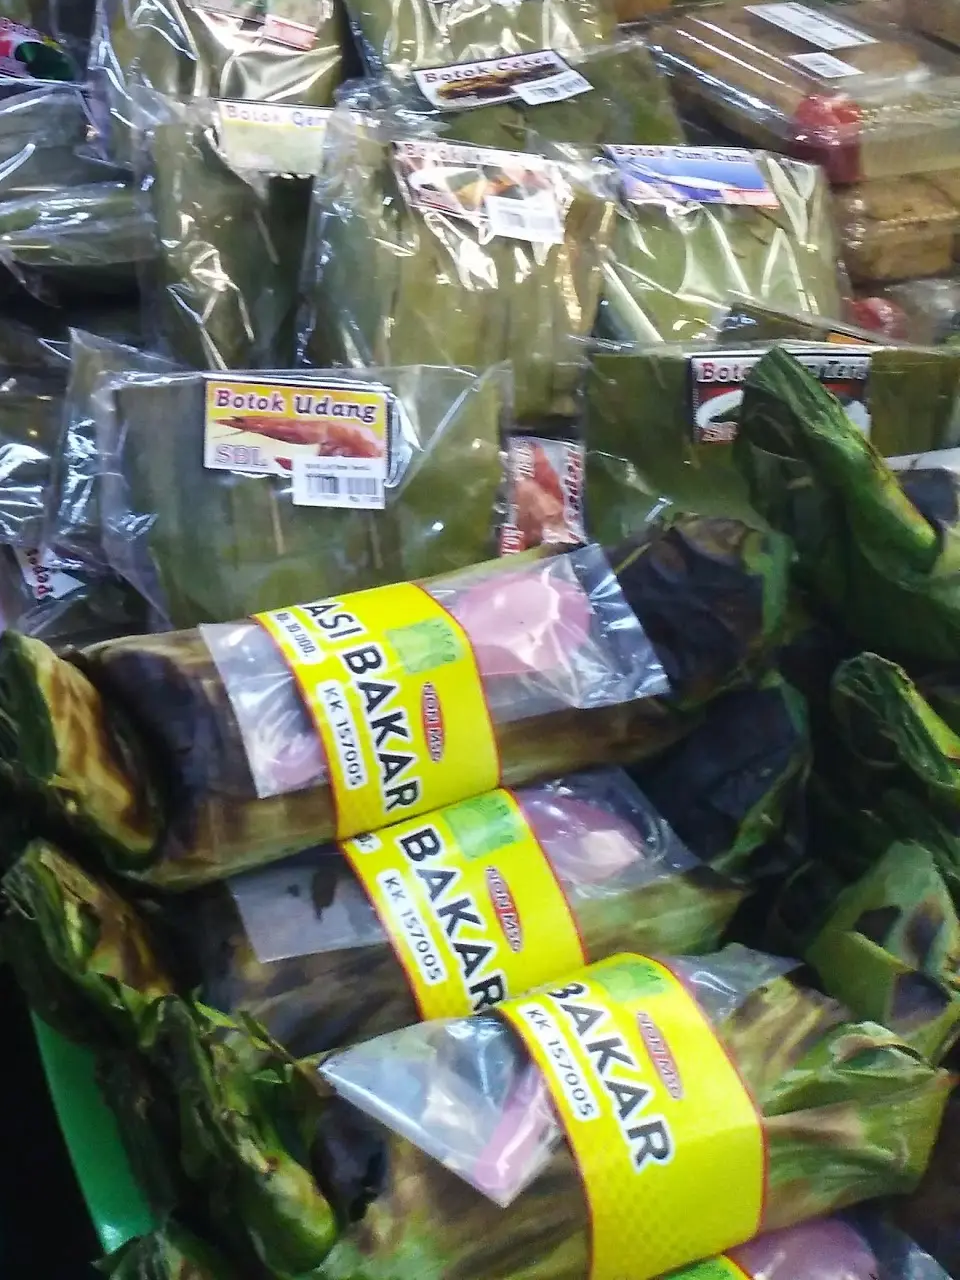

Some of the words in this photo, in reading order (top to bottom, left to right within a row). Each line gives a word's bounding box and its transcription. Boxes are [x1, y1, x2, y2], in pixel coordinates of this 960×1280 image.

[424, 65, 490, 84] Botok
[215, 389, 284, 412] Botok
[295, 395, 377, 424] Udang
[302, 603, 363, 640] ASI
[342, 644, 420, 813] BAKAR
[323, 686, 344, 713] KK
[336, 720, 363, 787] 157005
[384, 876, 406, 901] KK
[400, 908, 443, 981] 157005
[400, 827, 505, 1011] BAKAR
[525, 1008, 552, 1030] KK
[547, 1039, 595, 1117] 157005
